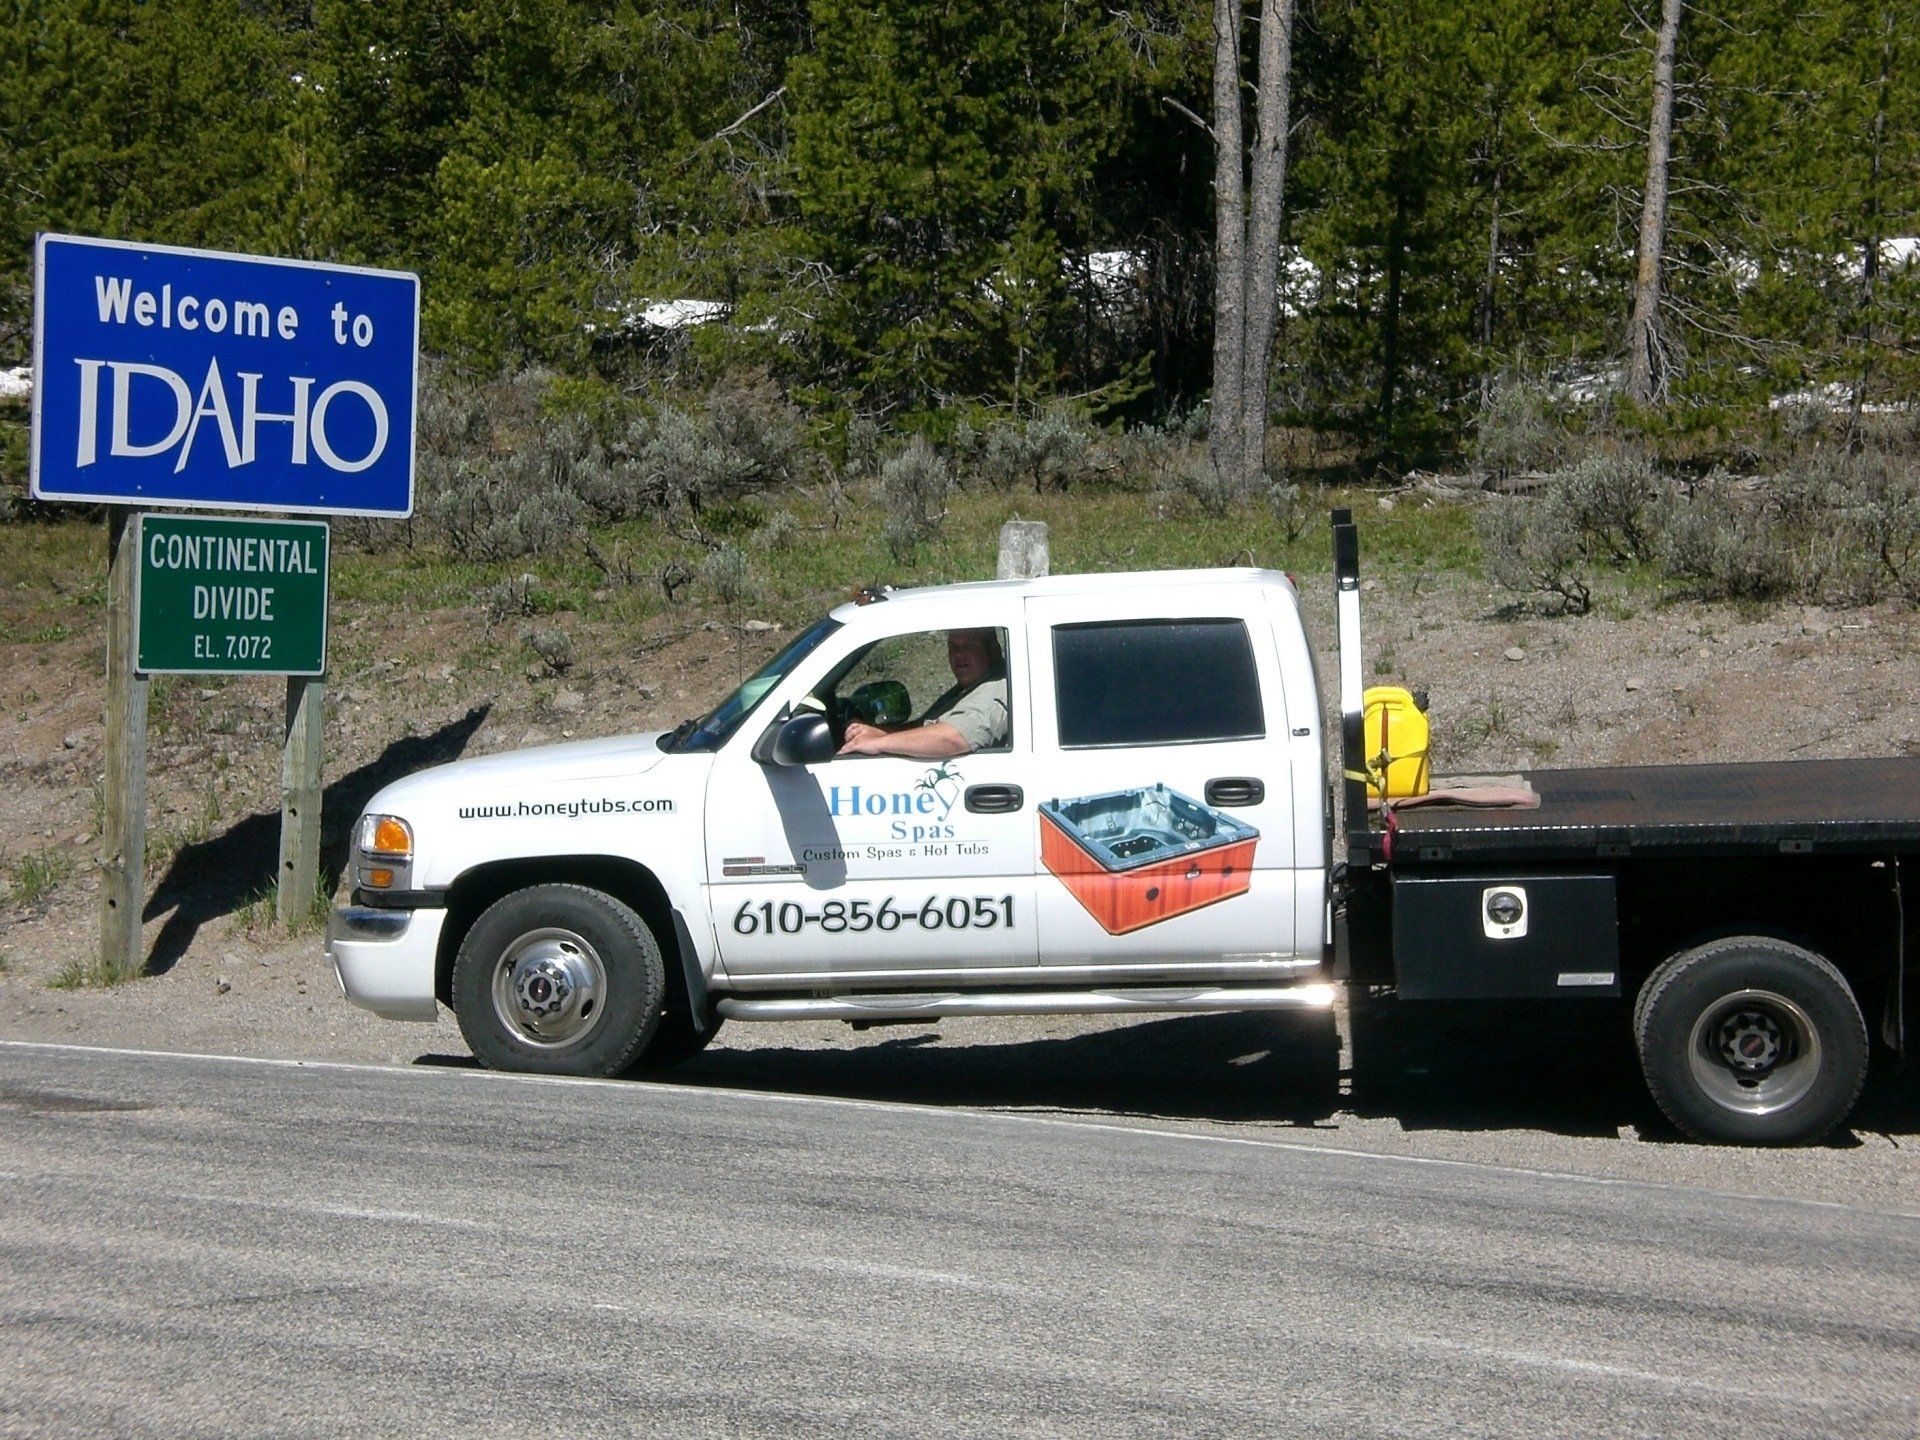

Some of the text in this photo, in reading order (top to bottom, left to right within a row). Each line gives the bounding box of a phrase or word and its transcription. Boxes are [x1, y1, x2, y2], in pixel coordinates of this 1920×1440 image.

[95, 276, 374, 348] Welcome to
[74, 356, 389, 474] IDAHO
[150, 533, 317, 574] CONTINENTAL
[194, 586, 274, 621] DIVIDE
[194, 636, 272, 661] EL. 7,072
[458, 798, 673, 819] www.honeytubs.com
[830, 785, 960, 821] Honey
[891, 821, 955, 843] Spas
[803, 848, 860, 862] Custom
[867, 846, 902, 861] Spas
[924, 844, 948, 857] Hot
[956, 843, 989, 855] Tubs
[733, 895, 1014, 934] 610-856-6051
